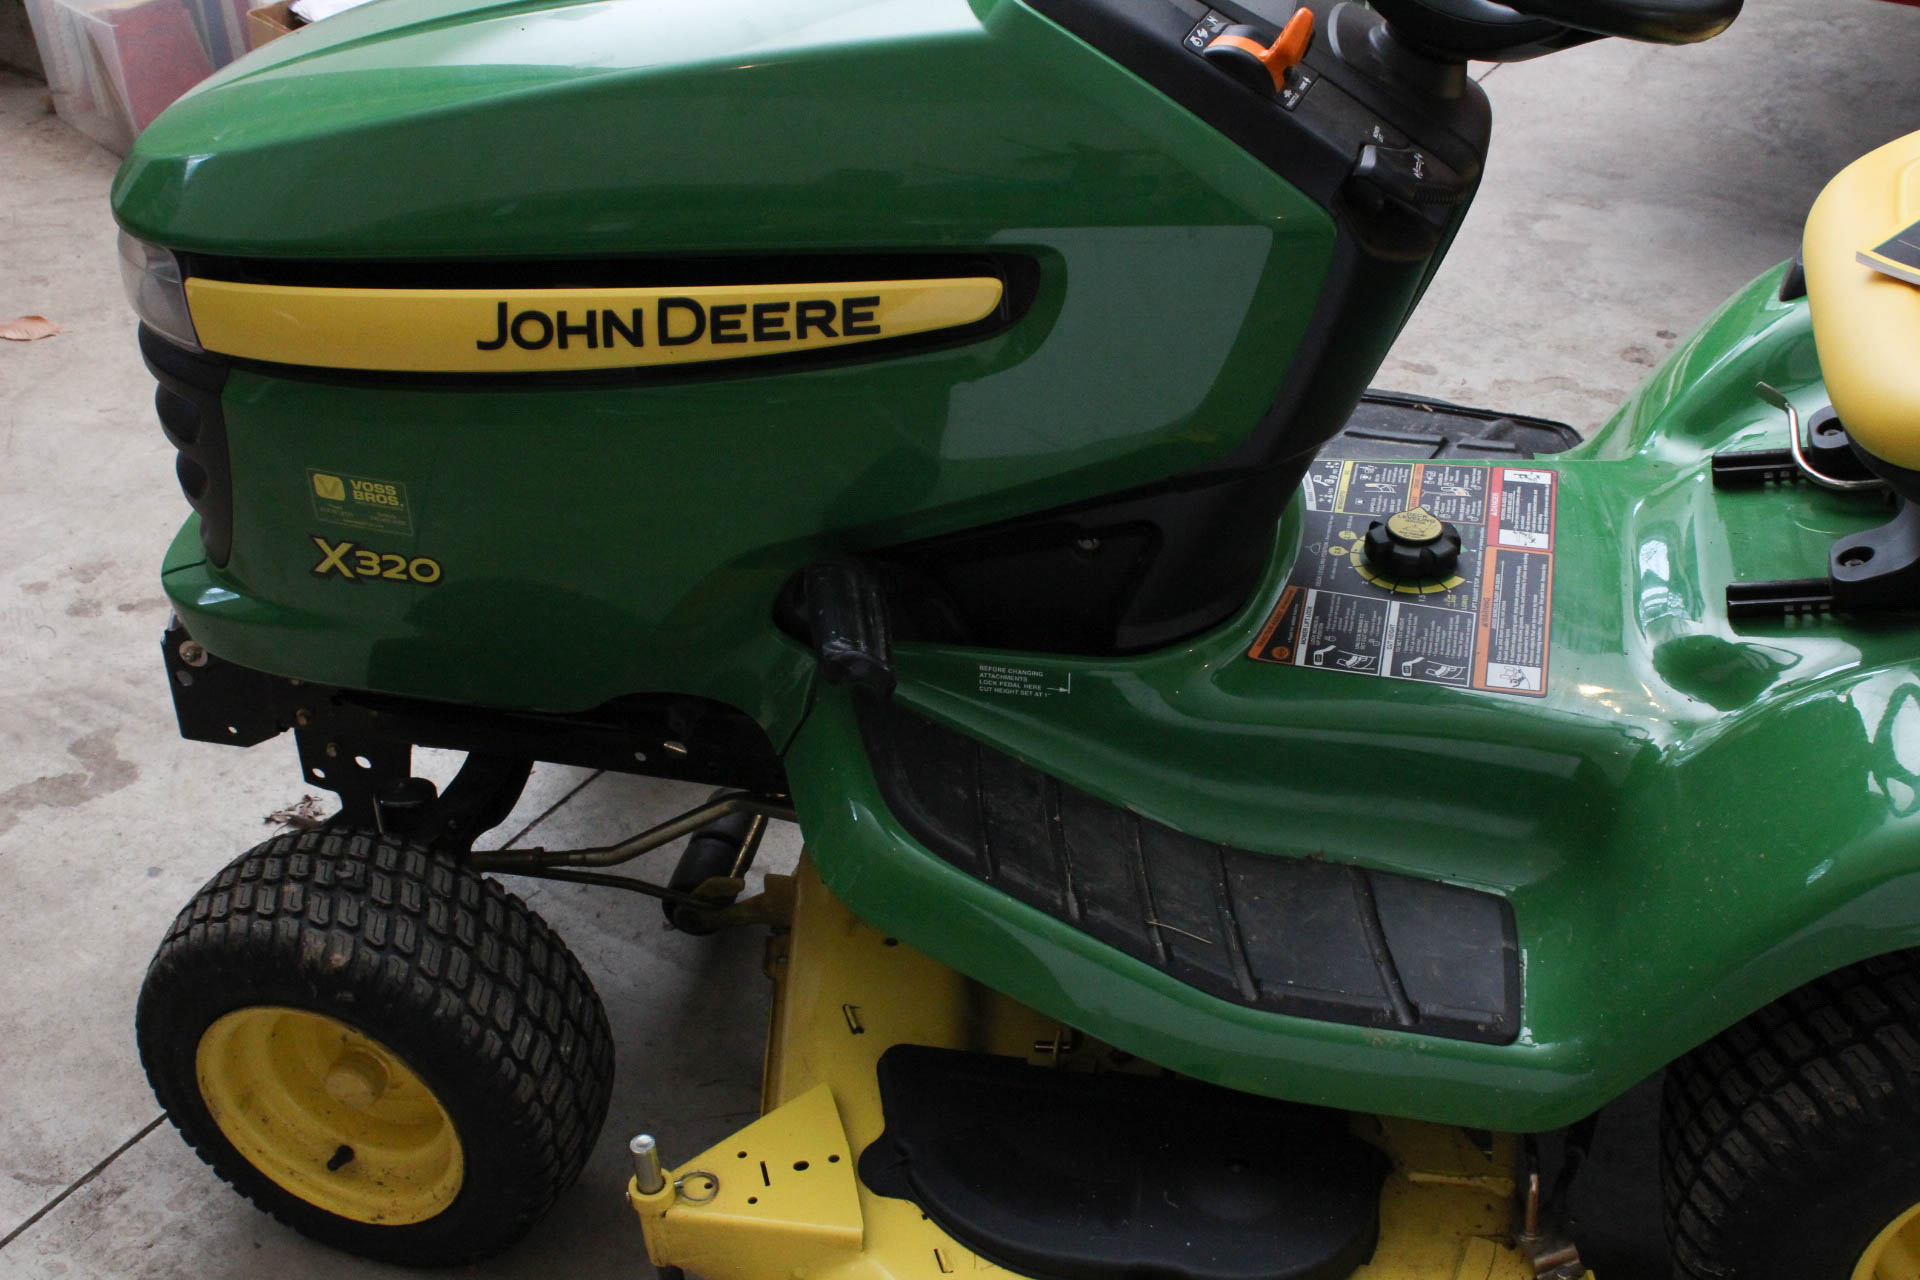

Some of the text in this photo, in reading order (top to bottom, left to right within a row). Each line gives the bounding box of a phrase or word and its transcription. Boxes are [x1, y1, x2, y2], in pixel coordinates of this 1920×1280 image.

[476, 295, 881, 350] JOHN DEERE
[350, 479, 397, 496] VOSS
[312, 536, 442, 583] X320
[1300, 606, 1313, 645] MOWER LIFT LOCK
[1387, 623, 1396, 640] HEIGHT
[979, 665, 1044, 677] BEFORE CHANGING
[979, 672, 1028, 683] ATTACHMENTS
[994, 687, 1019, 695] HEIGHT
[999, 680, 1021, 689] PEDAL
[1023, 683, 1042, 691] HERE
